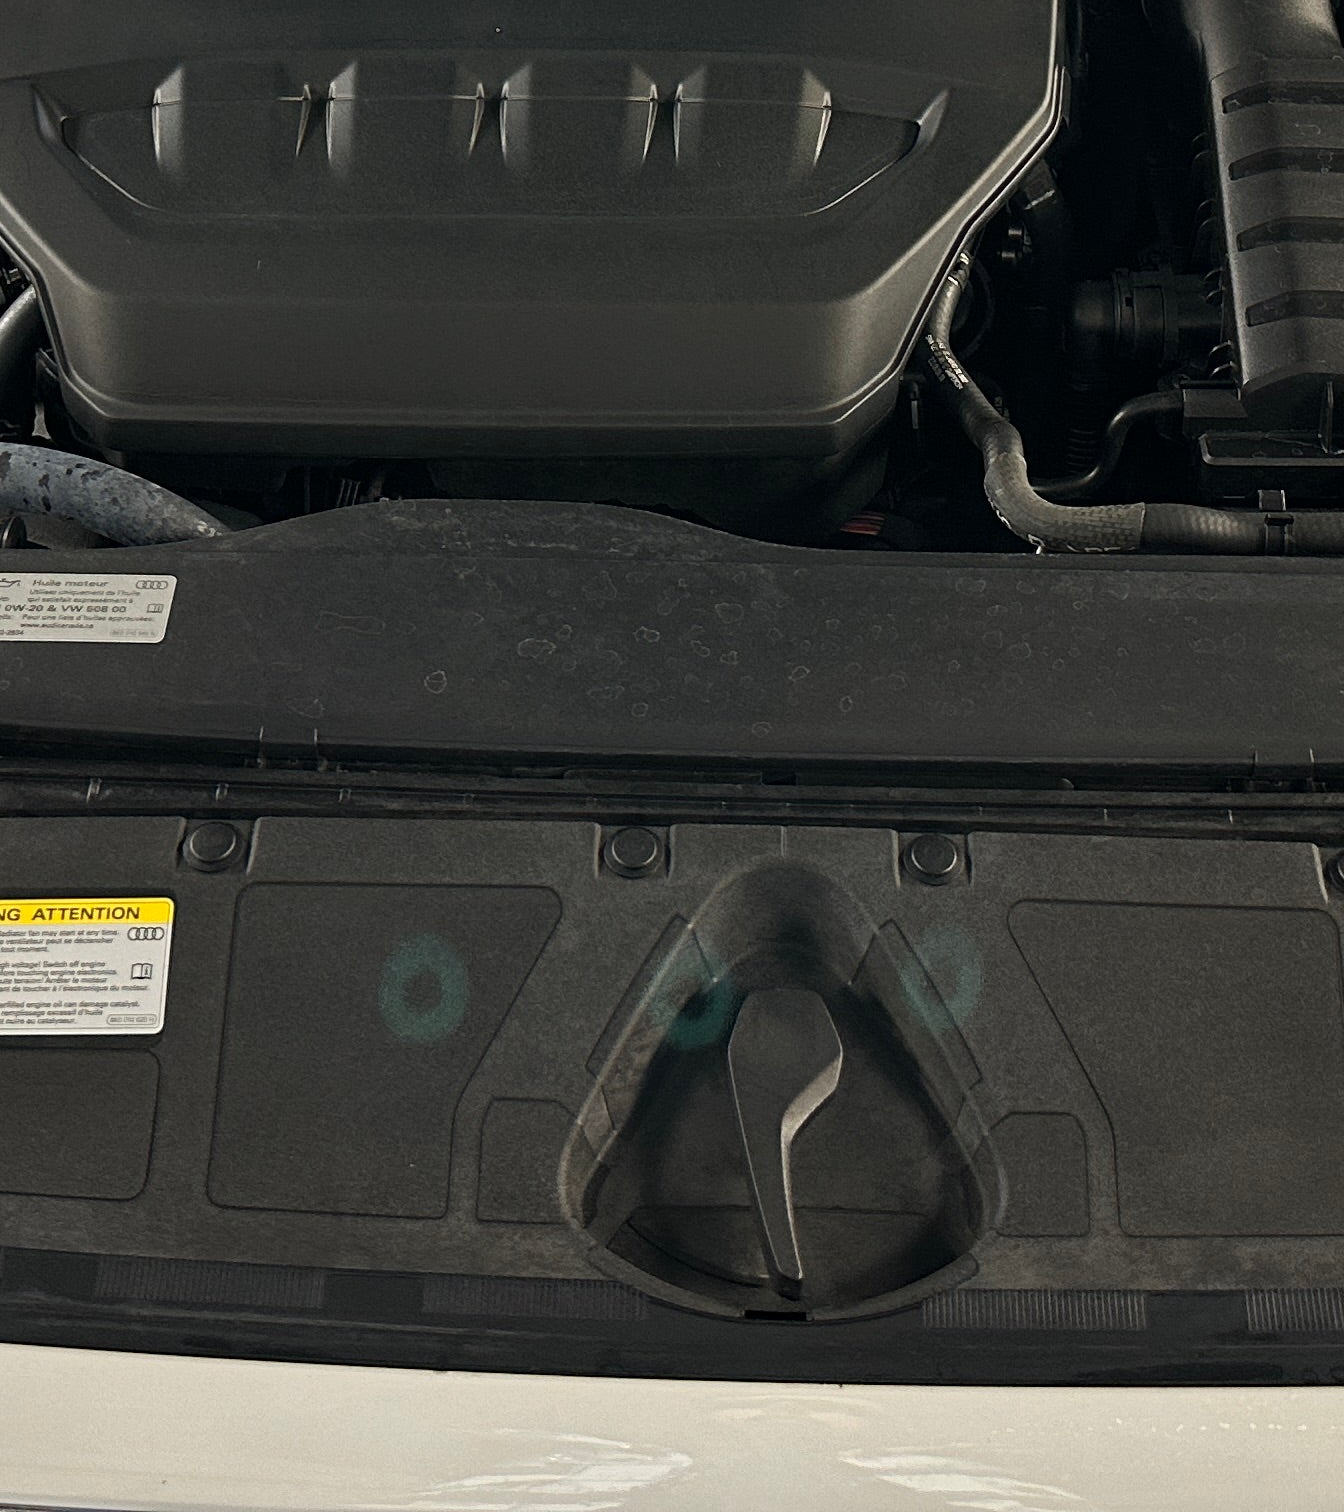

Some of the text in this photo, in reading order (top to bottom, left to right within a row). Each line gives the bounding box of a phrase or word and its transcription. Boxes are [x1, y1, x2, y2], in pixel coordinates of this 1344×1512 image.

[32, 579, 108, 587] Huile moteur
[46, 604, 57, 612] &
[111, 605, 126, 613] 00
[32, 907, 140, 921] ATTENTION
